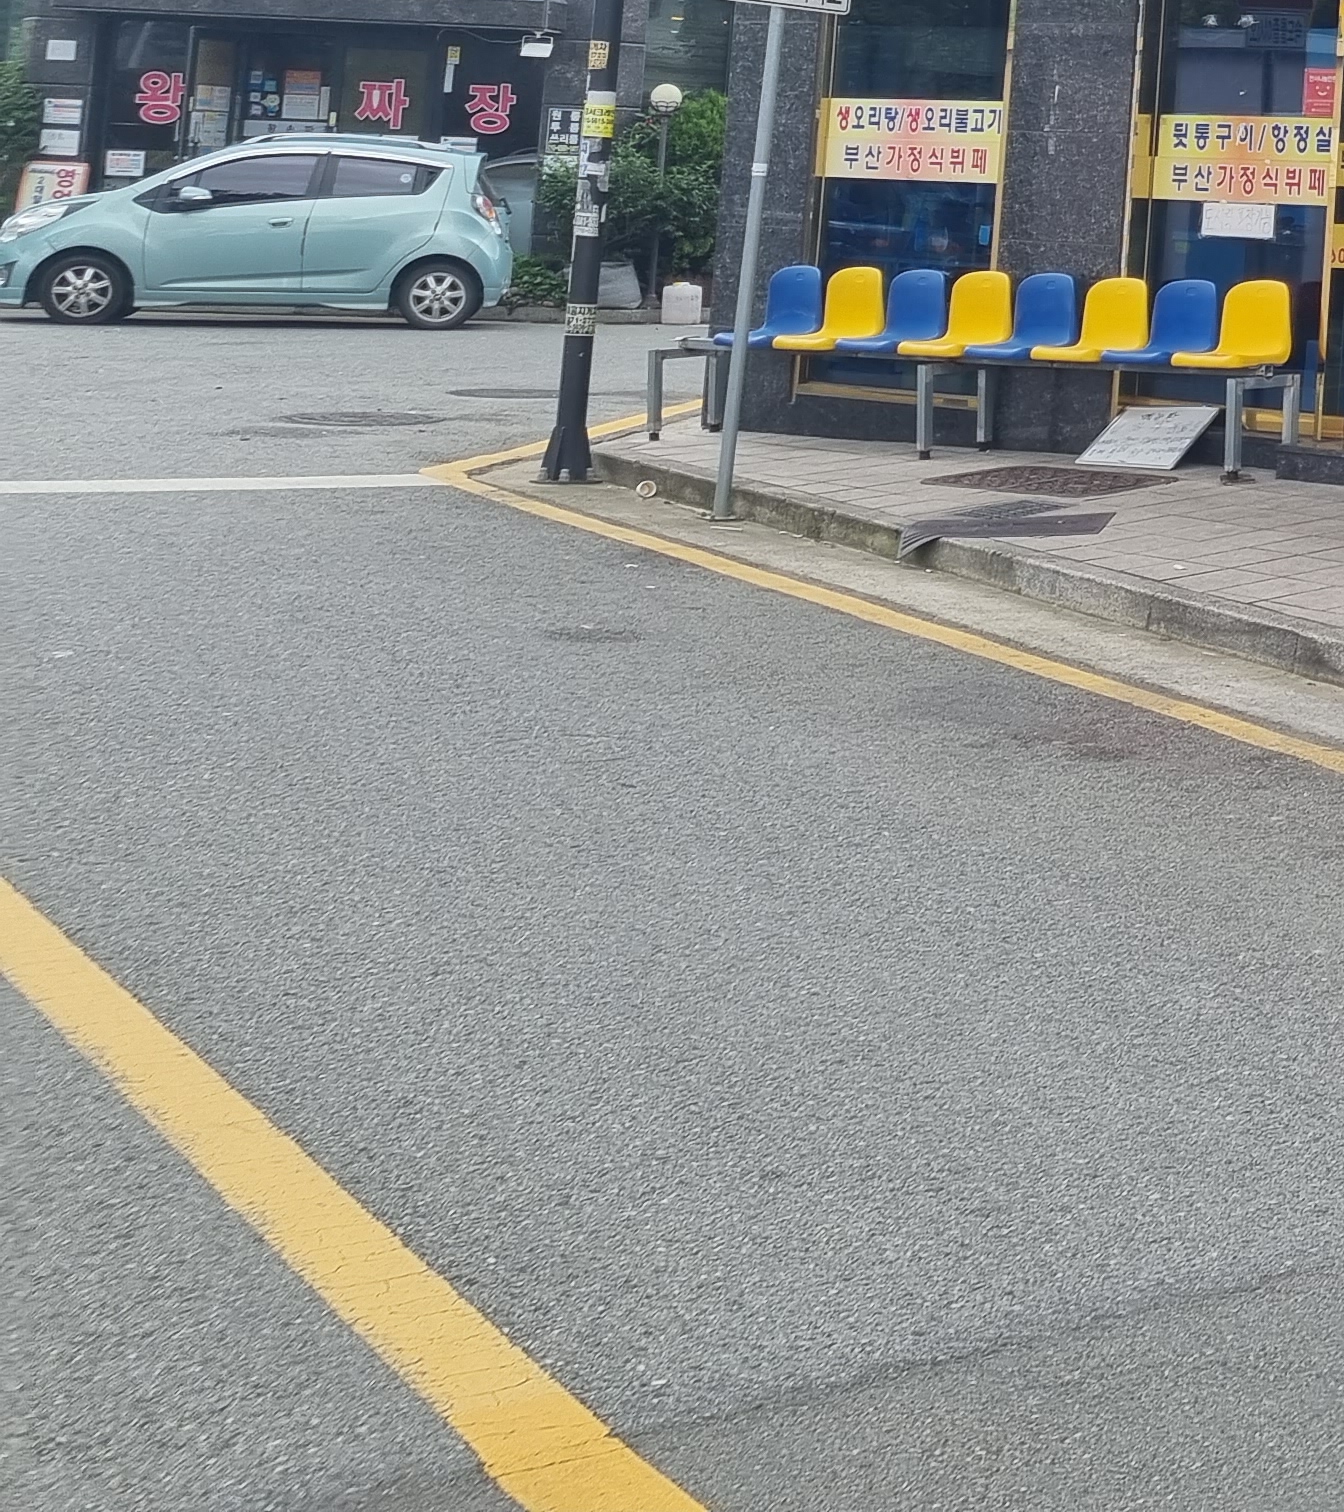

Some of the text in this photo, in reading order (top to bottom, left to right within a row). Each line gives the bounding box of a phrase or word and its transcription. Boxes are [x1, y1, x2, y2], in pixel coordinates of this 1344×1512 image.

[135, 71, 187, 124] 왕
[355, 79, 410, 130] 짜
[465, 83, 517, 134] 장
[836, 105, 1002, 136] 생오리탕/생오리불고기
[842, 144, 989, 176] 부산가정식뷔페
[1171, 164, 1326, 197] 부산가정식뷔페
